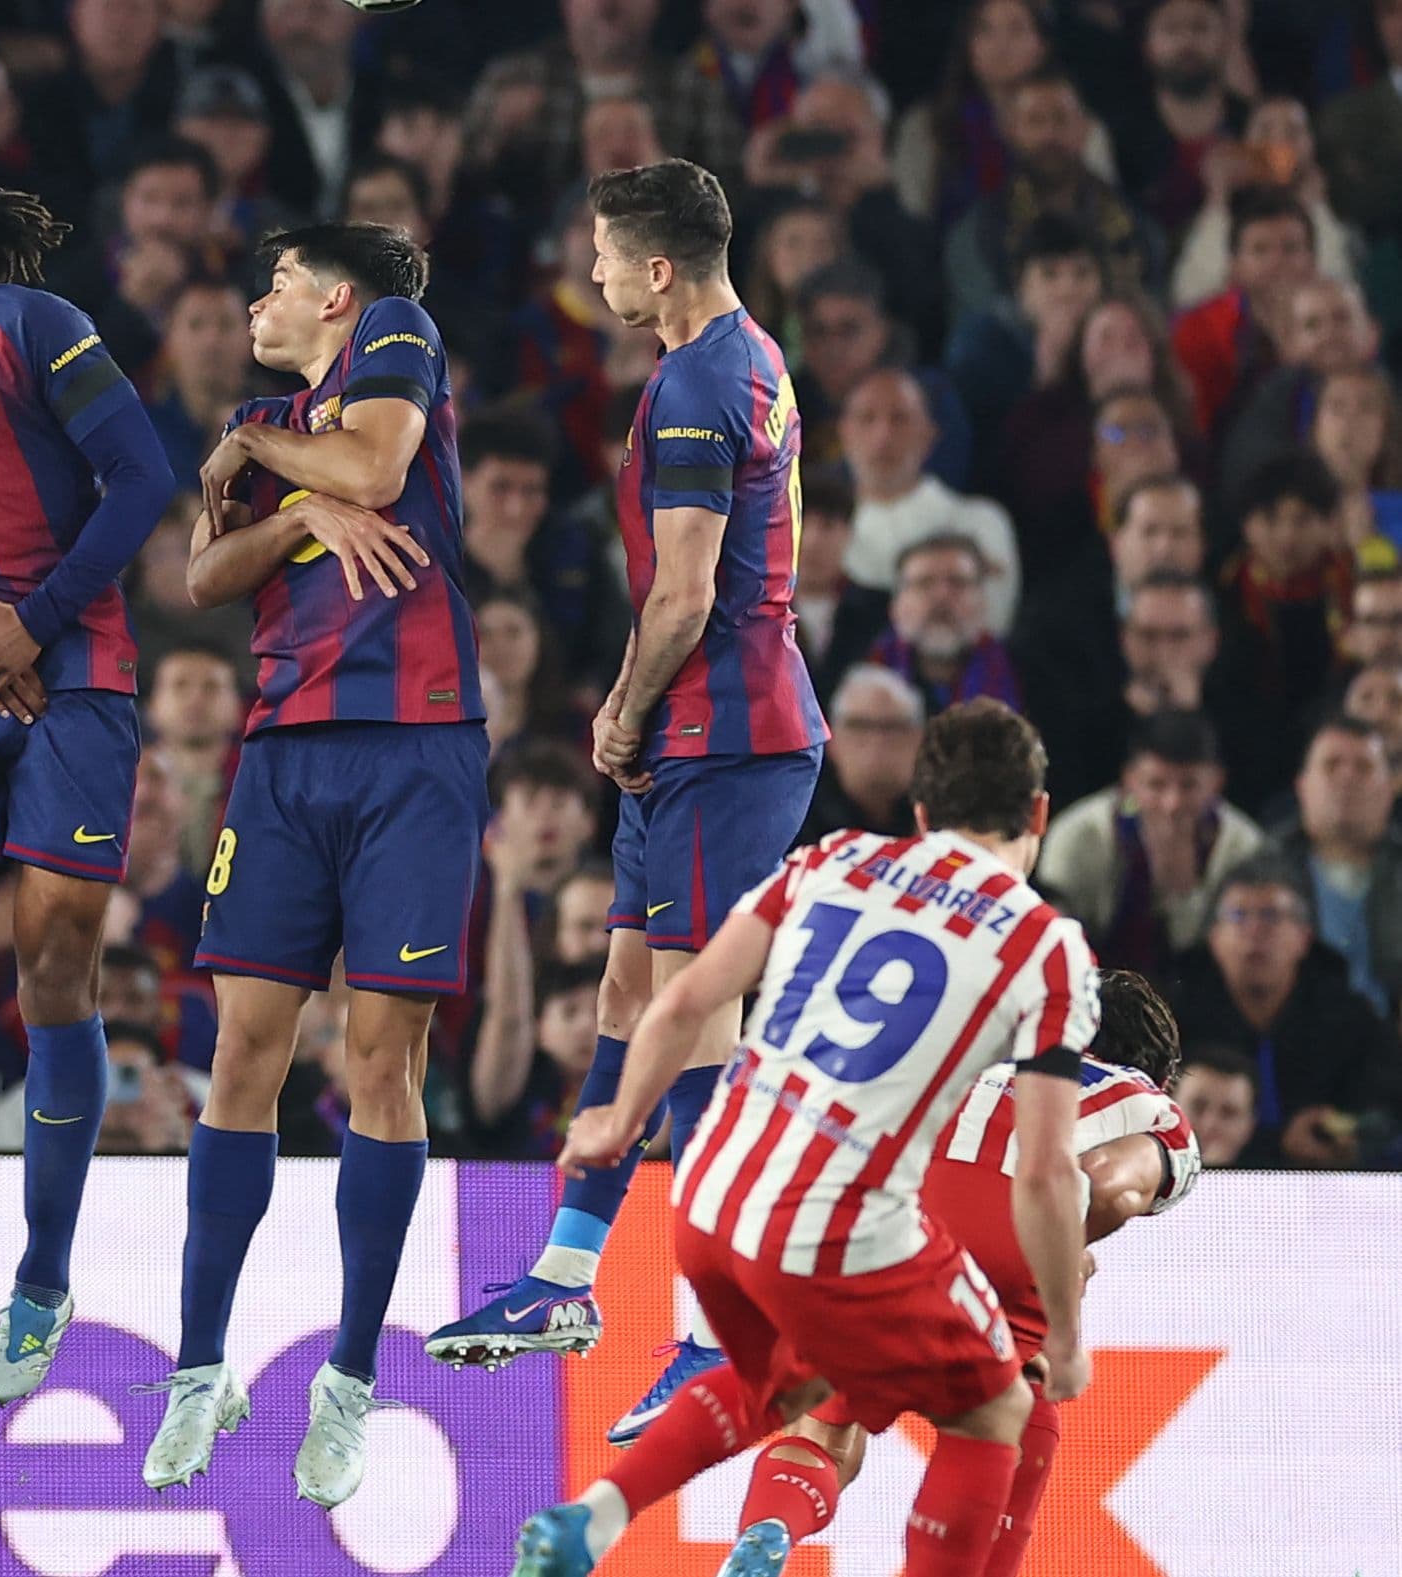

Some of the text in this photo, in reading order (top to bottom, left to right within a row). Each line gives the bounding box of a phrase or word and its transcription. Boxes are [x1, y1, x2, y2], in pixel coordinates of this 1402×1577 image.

[364, 333, 426, 354] AMBILIGHT
[657, 428, 725, 442] AMBILIGHT tv
[206, 828, 237, 895] 8
[864, 856, 1016, 935] ALVAREZ
[761, 902, 948, 1084] 19
[771, 1473, 828, 1518] ATLETI
